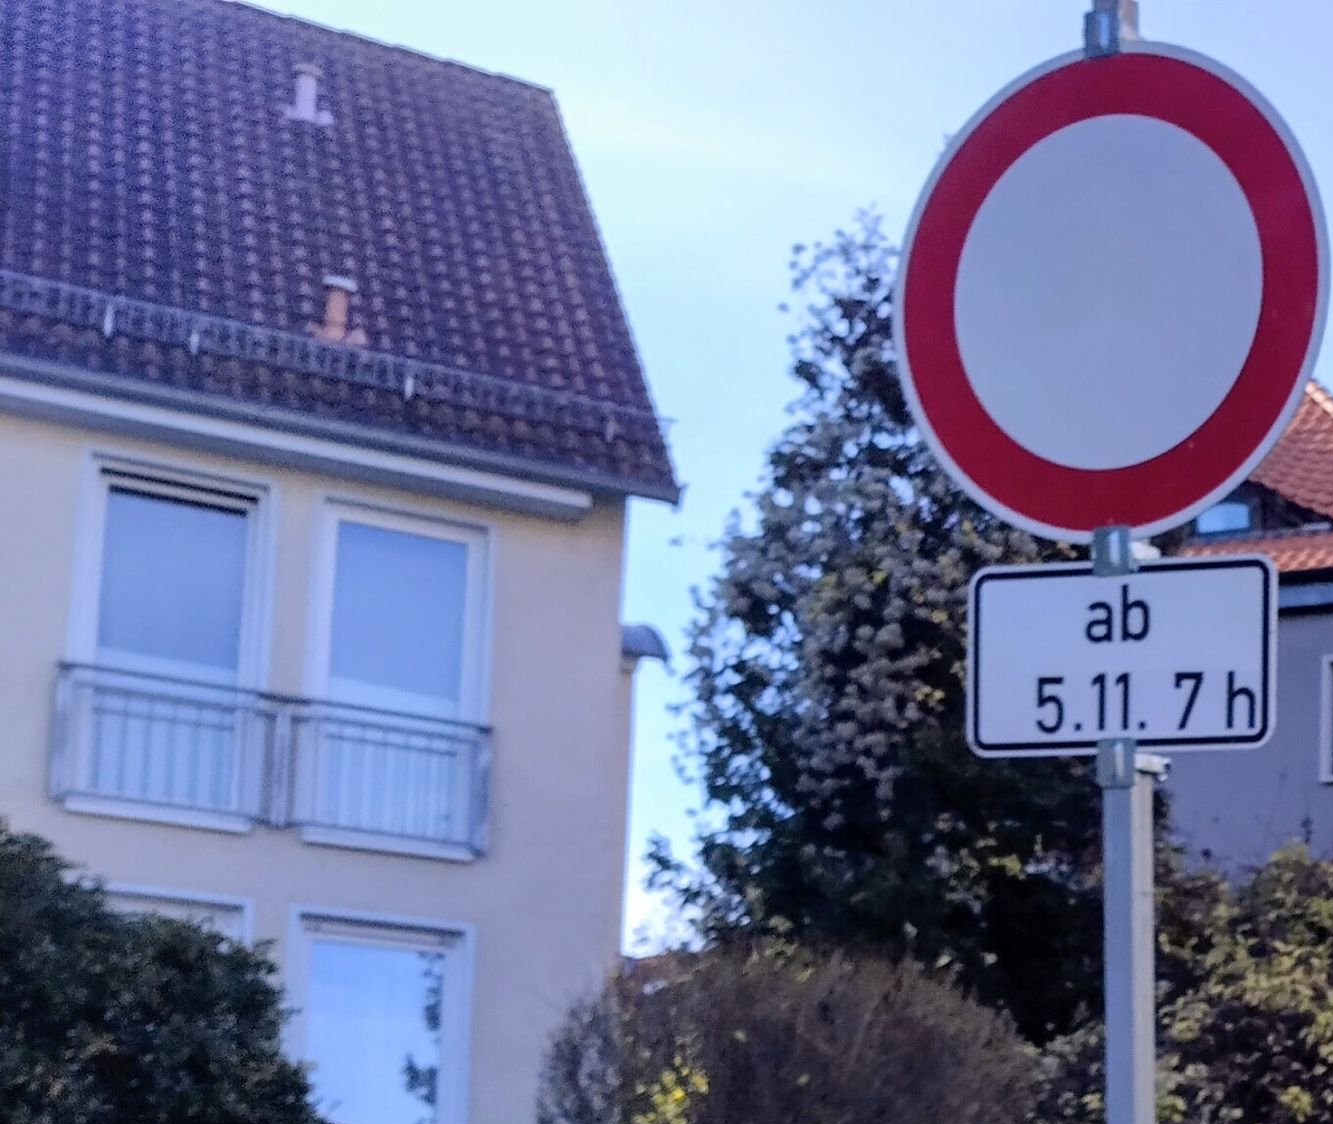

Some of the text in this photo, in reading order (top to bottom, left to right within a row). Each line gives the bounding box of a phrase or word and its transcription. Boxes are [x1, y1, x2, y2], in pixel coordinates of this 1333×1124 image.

[1085, 583, 1151, 643] ab
[1035, 670, 1256, 735] 5.11. 7 h
